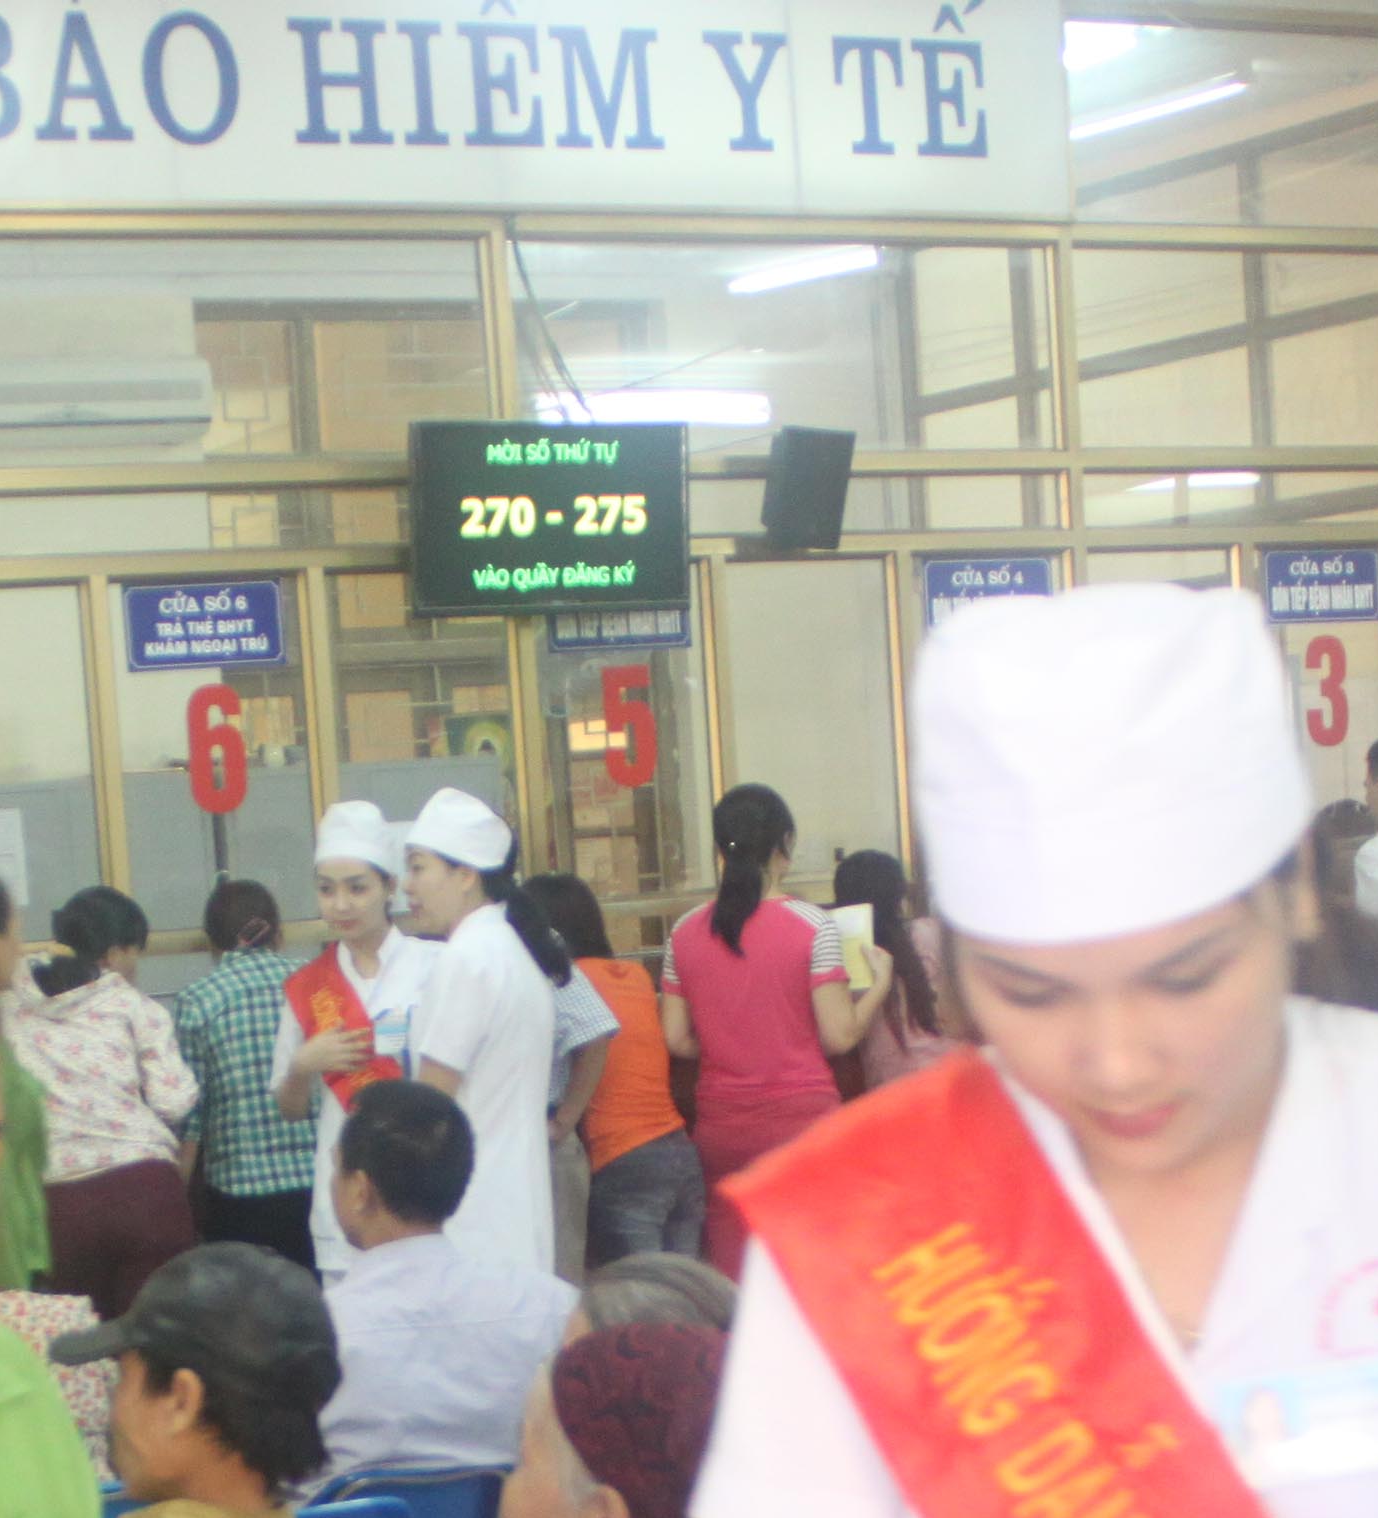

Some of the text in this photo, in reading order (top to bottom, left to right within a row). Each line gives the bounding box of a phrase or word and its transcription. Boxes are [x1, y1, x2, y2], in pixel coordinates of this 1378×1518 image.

[702, 30, 788, 151] Y
[831, 0, 989, 158] TẾ
[459, 495, 536, 540] 270
[573, 493, 648, 536] 275
[473, 563, 511, 590] VÀO
[561, 561, 611, 588] ĐĂNG
[612, 559, 636, 586] KÝ
[951, 563, 1024, 585] CỬA SỐ 4
[1289, 554, 1355, 575] CỬA SỐ 3
[158, 588, 248, 614] CỬA SỐ 6
[216, 618, 255, 635] BHYT
[189, 637, 239, 656] NGOẠI
[1305, 635, 1350, 747] 3
[602, 664, 658, 788] 5
[185, 683, 248, 814] 6
[871, 1220, 1058, 1439] HƯỚNG
